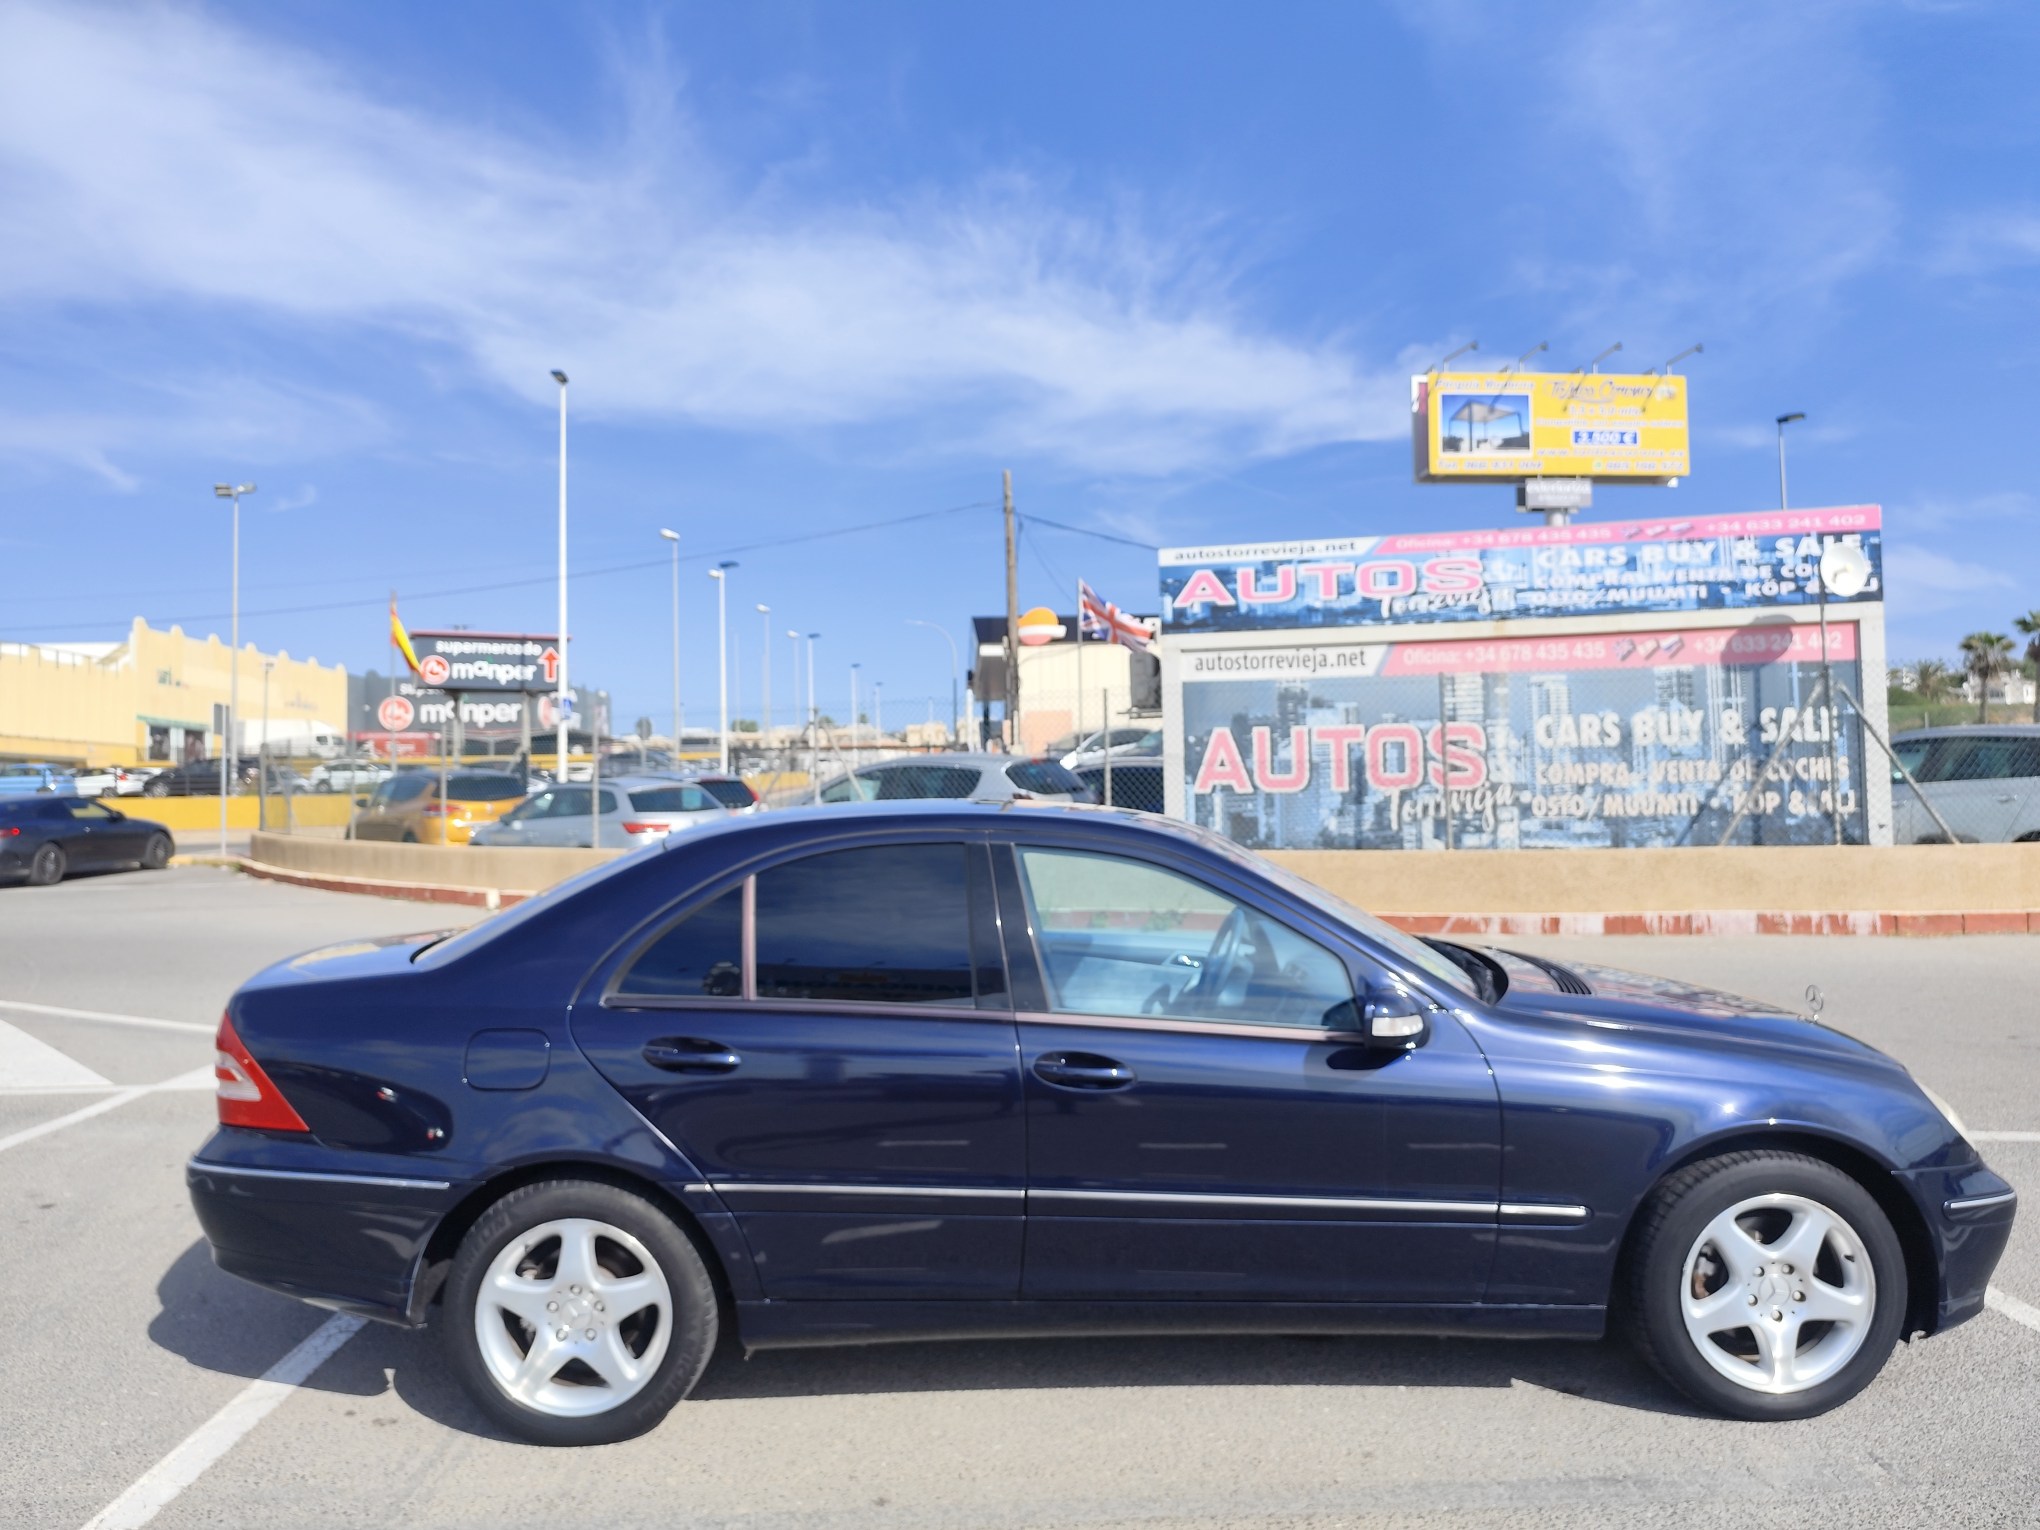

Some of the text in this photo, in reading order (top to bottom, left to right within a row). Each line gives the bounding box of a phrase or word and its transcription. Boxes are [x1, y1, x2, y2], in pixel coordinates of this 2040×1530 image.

[1706, 521, 1741, 533] +34
[1746, 518, 1782, 531] 633
[1175, 540, 1357, 561] autostorrevieja.net
[1396, 536, 1456, 549] Oficina:
[1463, 533, 1494, 546] +34
[1500, 531, 1532, 544] 678
[1538, 529, 1572, 542] 435
[1536, 545, 1628, 569] CARS
[1641, 540, 1718, 564] BUY
[1172, 557, 1487, 608] AUTOS
[1535, 570, 1639, 590] COMPRA
[1655, 565, 1734, 585] VENTA
[1742, 564, 1773, 580] DE
[436, 640, 543, 657] supermercado
[1403, 640, 1606, 665] Oficina: +34 678 435 435
[1694, 635, 1726, 654] +34
[1731, 634, 1767, 653] 633
[1770, 632, 1803, 652] 241
[1195, 649, 1367, 673] autostorrevieja.net
[1535, 710, 1621, 748] CARS
[1630, 708, 1704, 747] BUY
[1720, 707, 1746, 745] &
[1194, 721, 1487, 794] AUTOS
[1536, 760, 1630, 786] COMPRA
[1651, 757, 1721, 784] VENTA
